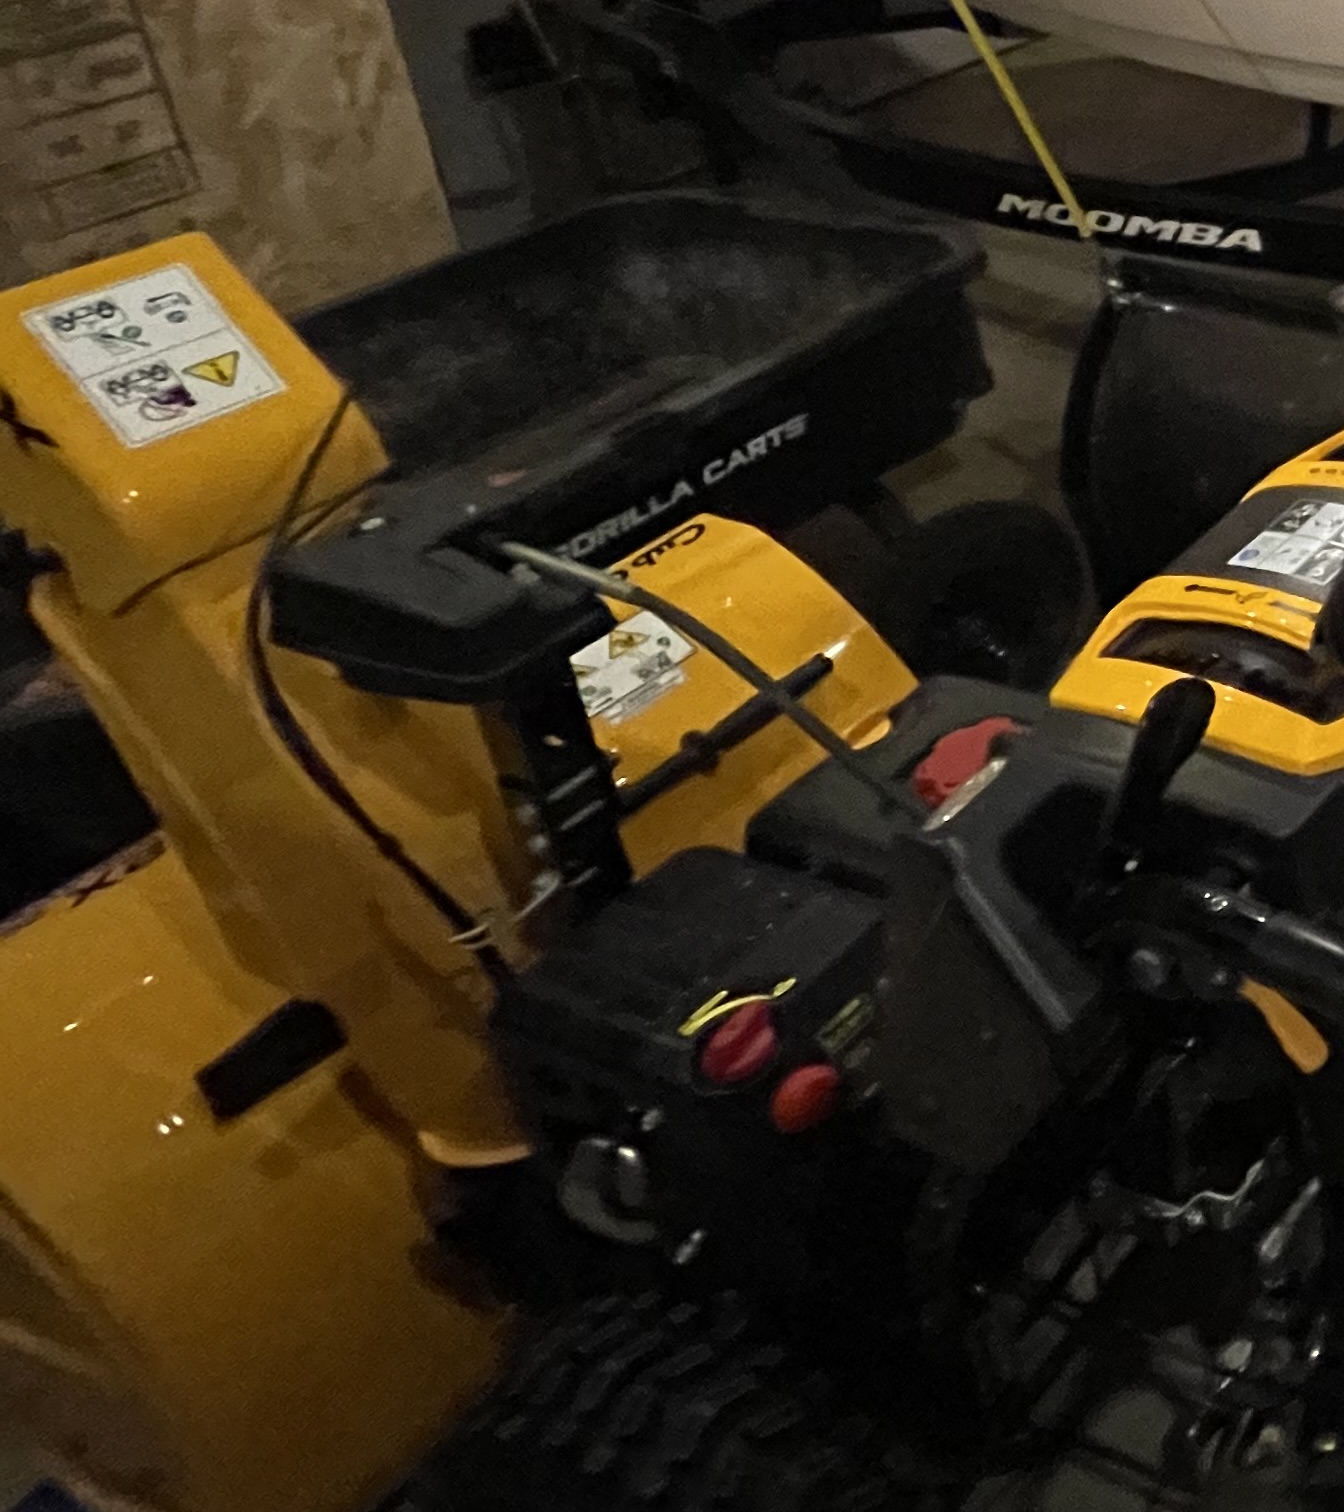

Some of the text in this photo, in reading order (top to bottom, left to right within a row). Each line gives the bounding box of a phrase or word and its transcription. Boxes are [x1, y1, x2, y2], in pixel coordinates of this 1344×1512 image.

[998, 192, 1262, 253] MOOMBA
[702, 412, 810, 486] CARTS
[630, 522, 706, 568] Cub
